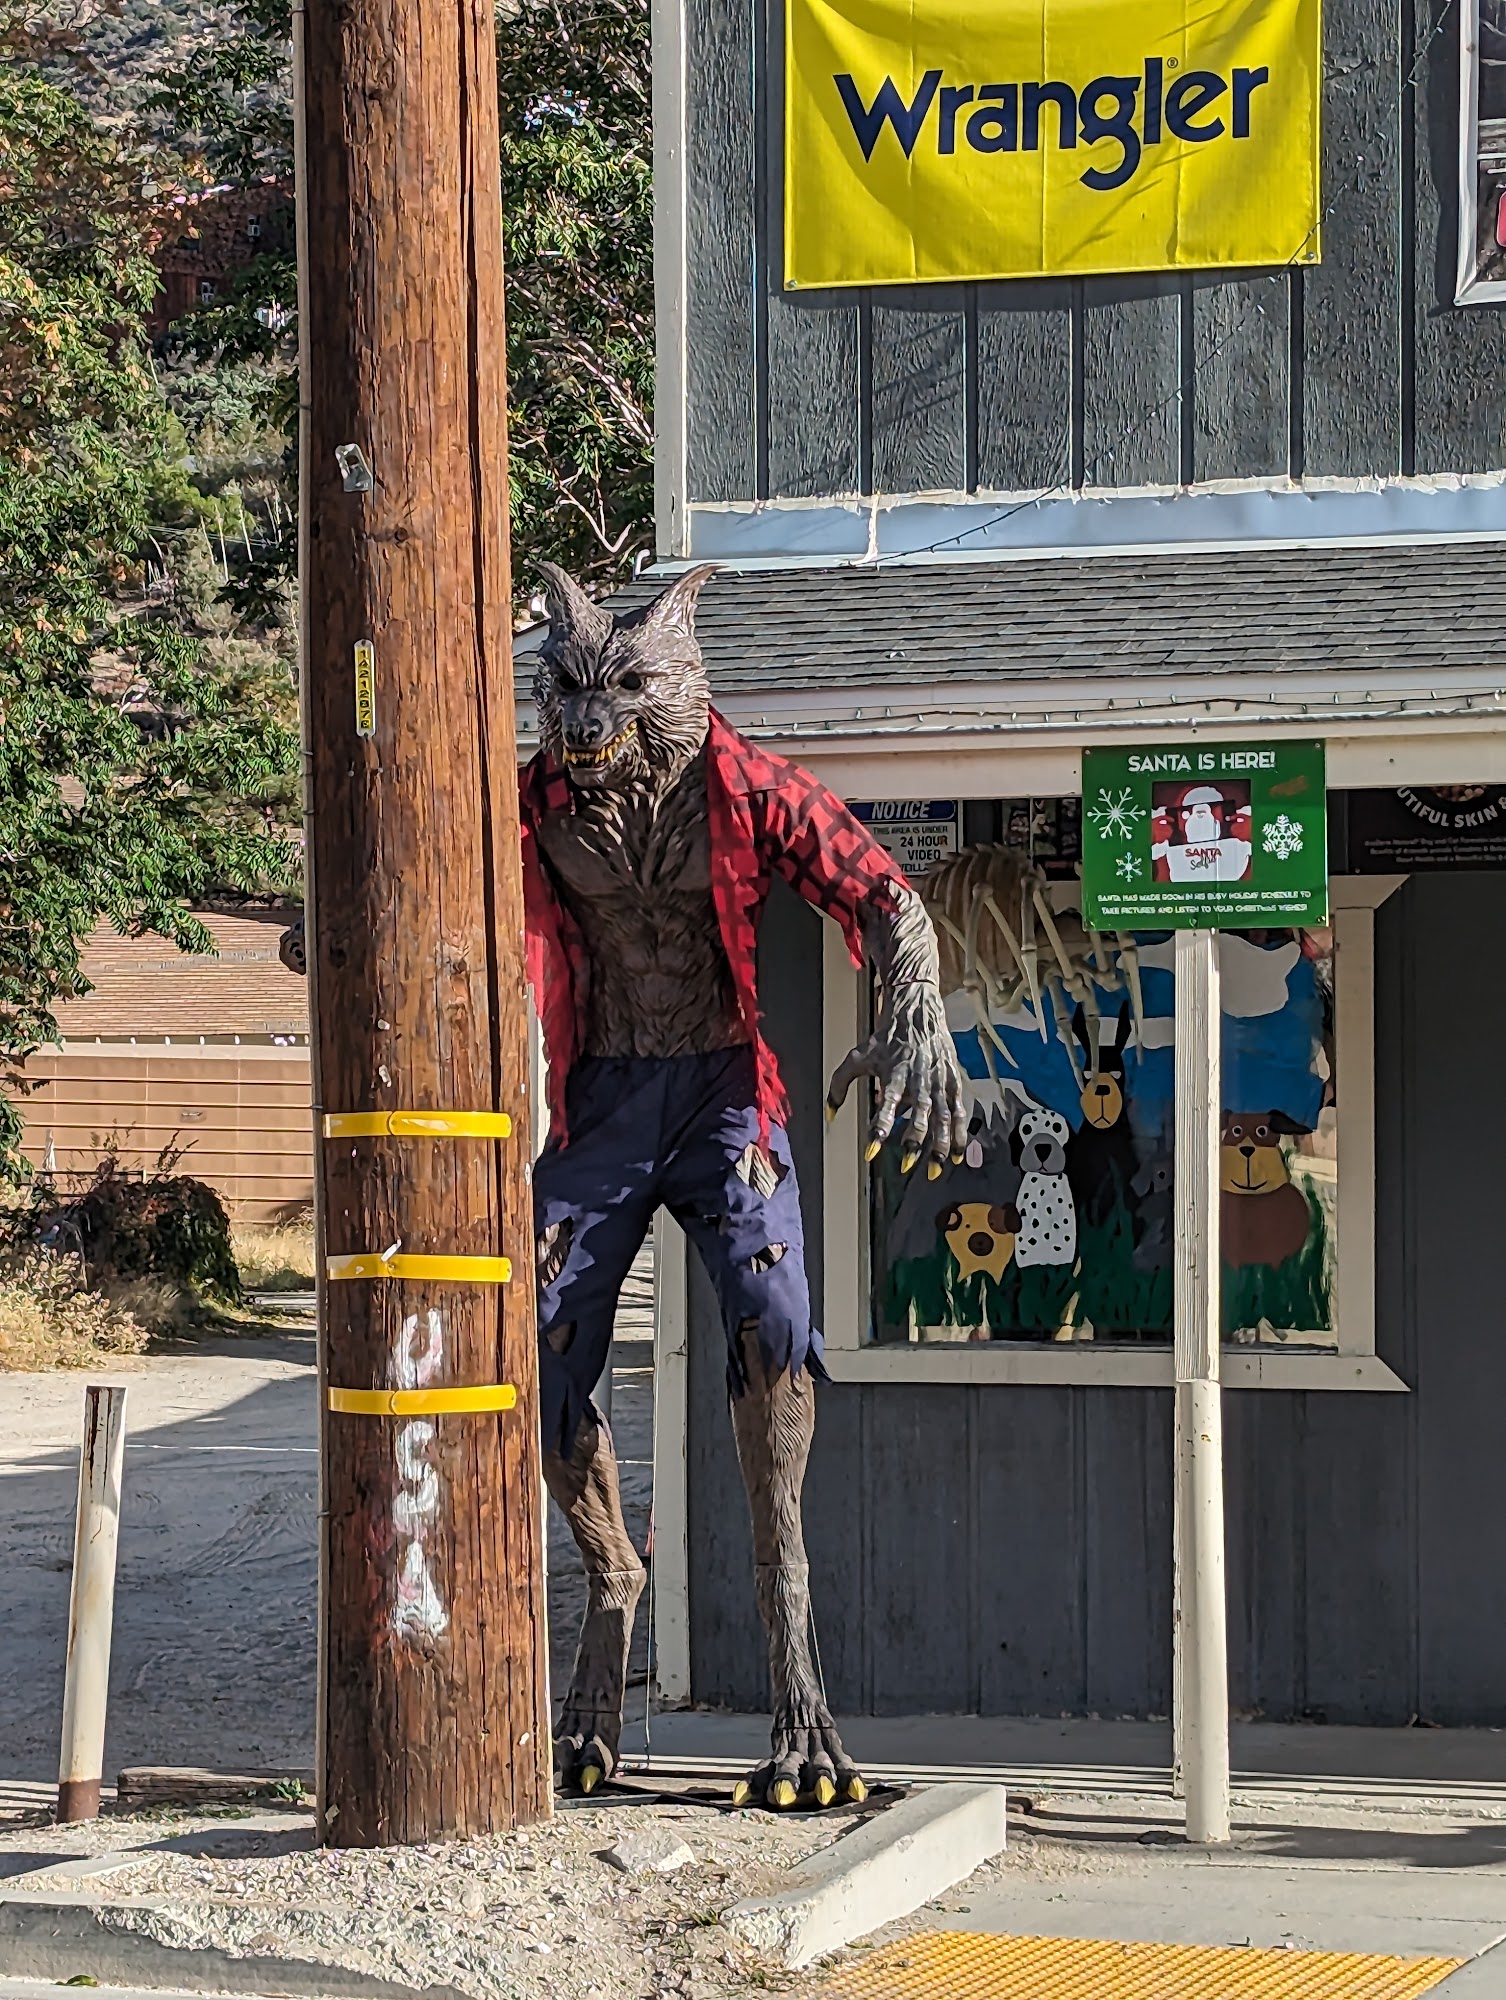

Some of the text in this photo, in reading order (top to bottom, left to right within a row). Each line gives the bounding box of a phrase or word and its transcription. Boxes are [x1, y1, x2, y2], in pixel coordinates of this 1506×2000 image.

[833, 57, 1269, 191] Wrangler
[1128, 751, 1275, 772] SANTA IS HERE!
[871, 801, 931, 819] NOTICE
[1396, 786, 1449, 827] UTIFUL
[1454, 804, 1498, 828] SKIN
[900, 835, 948, 847] 24 HOUR
[907, 849, 941, 861] VIDEO
[1185, 848, 1222, 857] SANTA
[1201, 905, 1211, 913] TO
